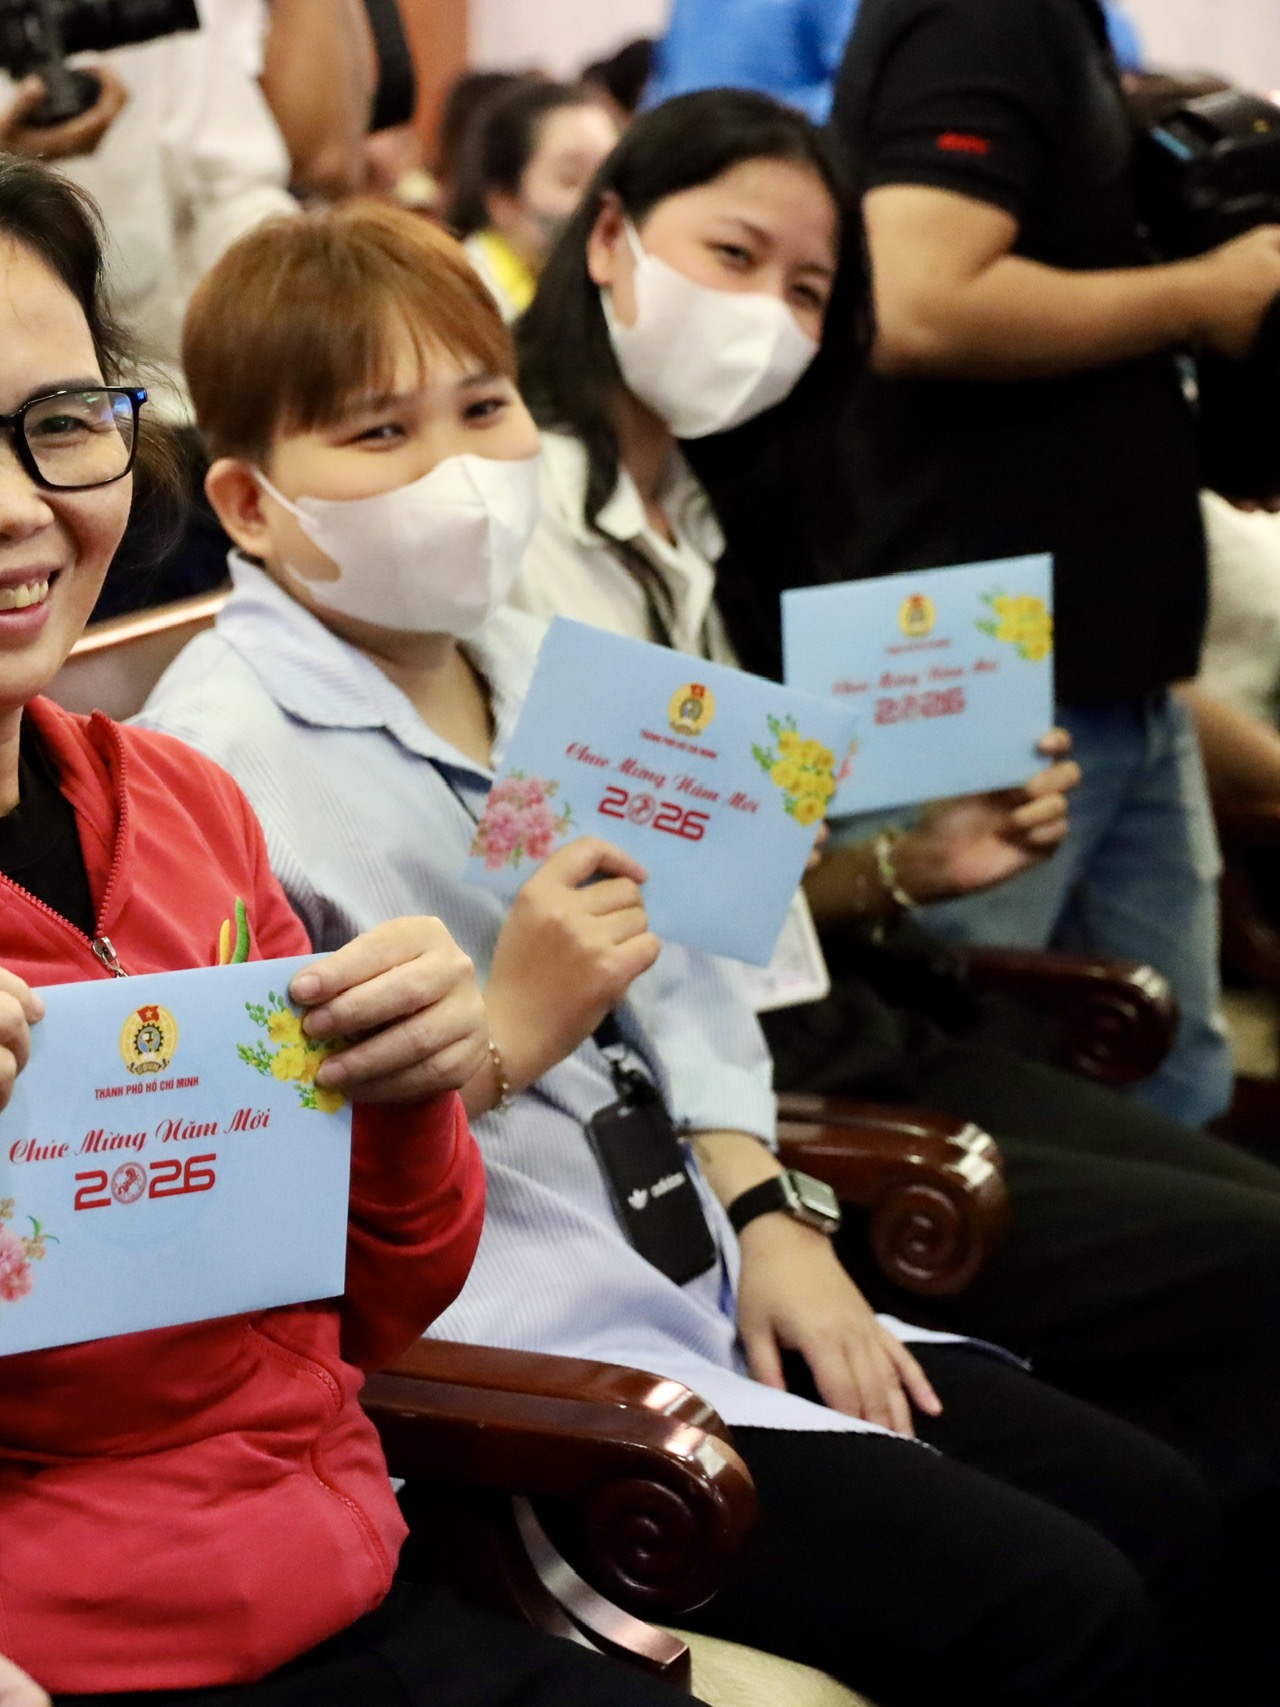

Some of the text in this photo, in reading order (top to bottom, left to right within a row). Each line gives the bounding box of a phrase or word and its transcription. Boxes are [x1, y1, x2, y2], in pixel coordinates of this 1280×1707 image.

[597, 785, 711, 842] 2026
[95, 1086, 124, 1099] THÀNH
[160, 1078, 175, 1091] CHÍ
[176, 1076, 200, 1088] MINH
[8, 1108, 270, 1164] Chúc Mừng Năm Mới
[74, 1152, 217, 1212] 2026
